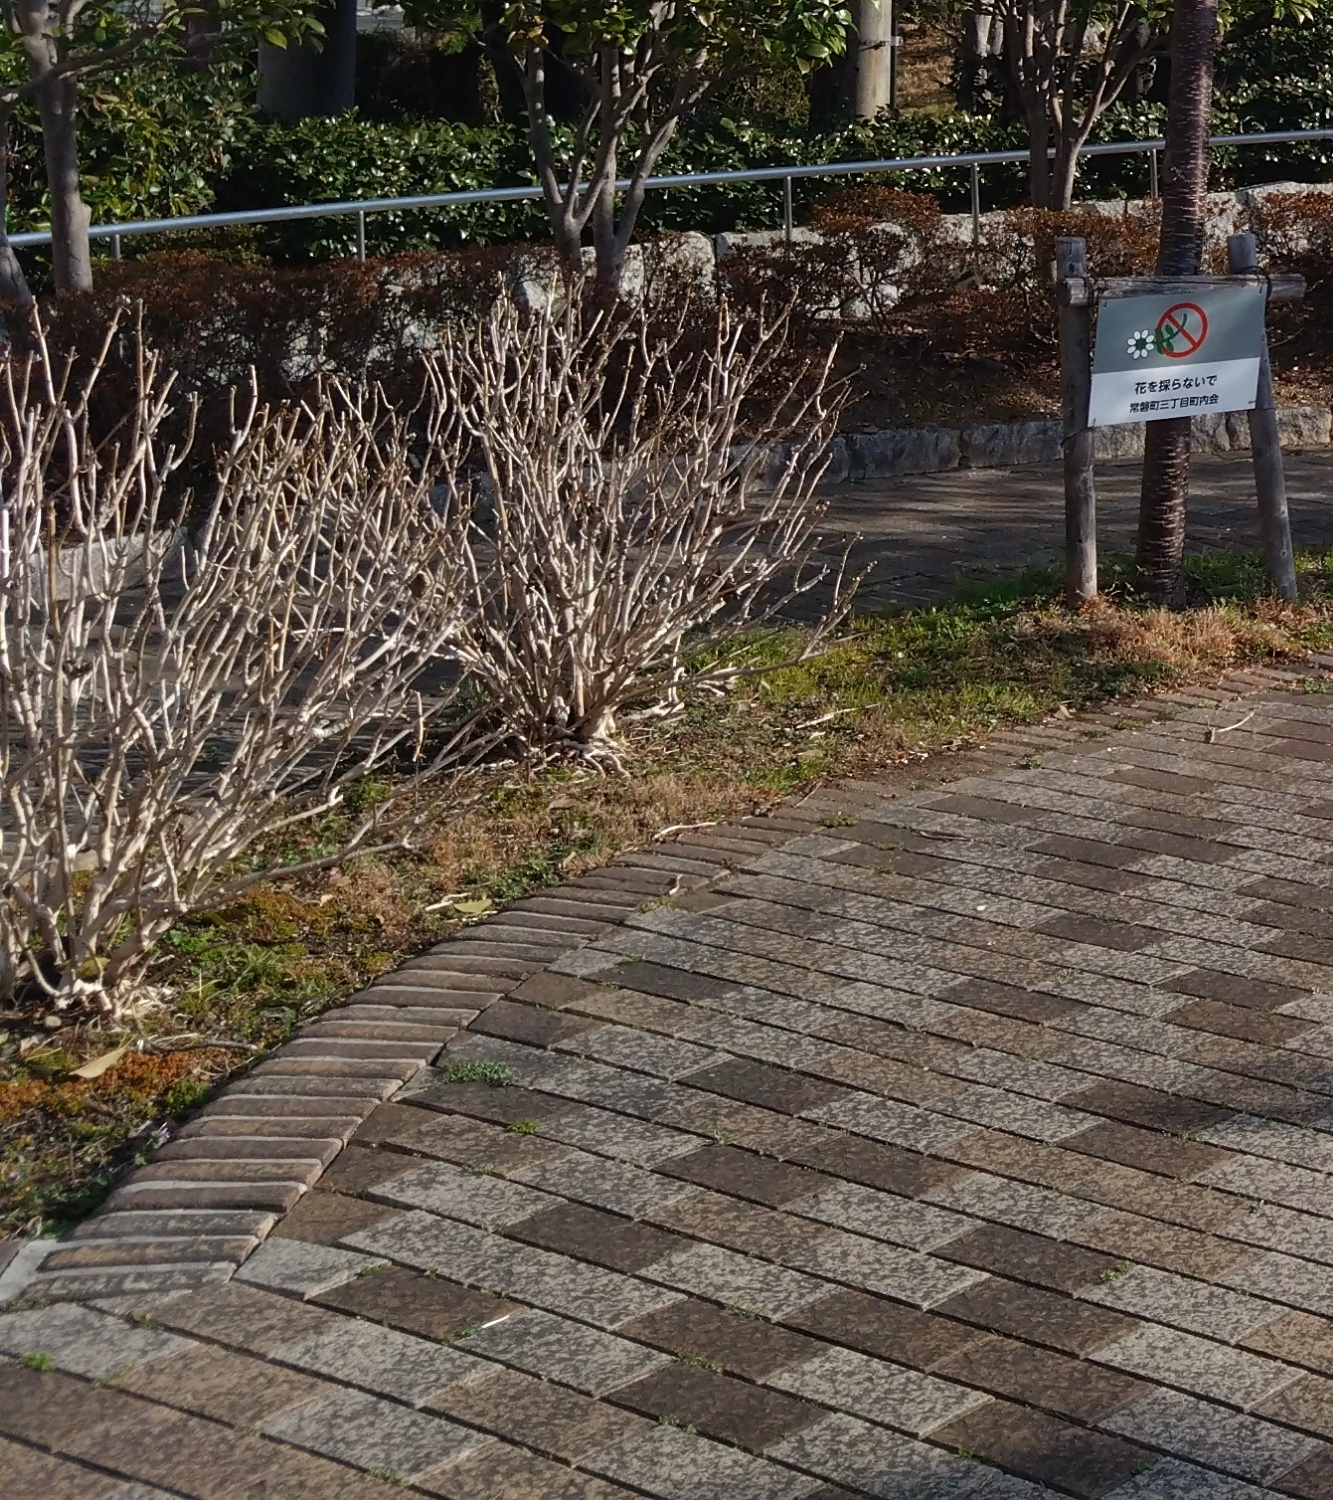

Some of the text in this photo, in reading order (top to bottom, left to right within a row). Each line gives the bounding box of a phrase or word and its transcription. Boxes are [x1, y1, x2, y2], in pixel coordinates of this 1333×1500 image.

[1135, 375, 1217, 395] 花を採らないで
